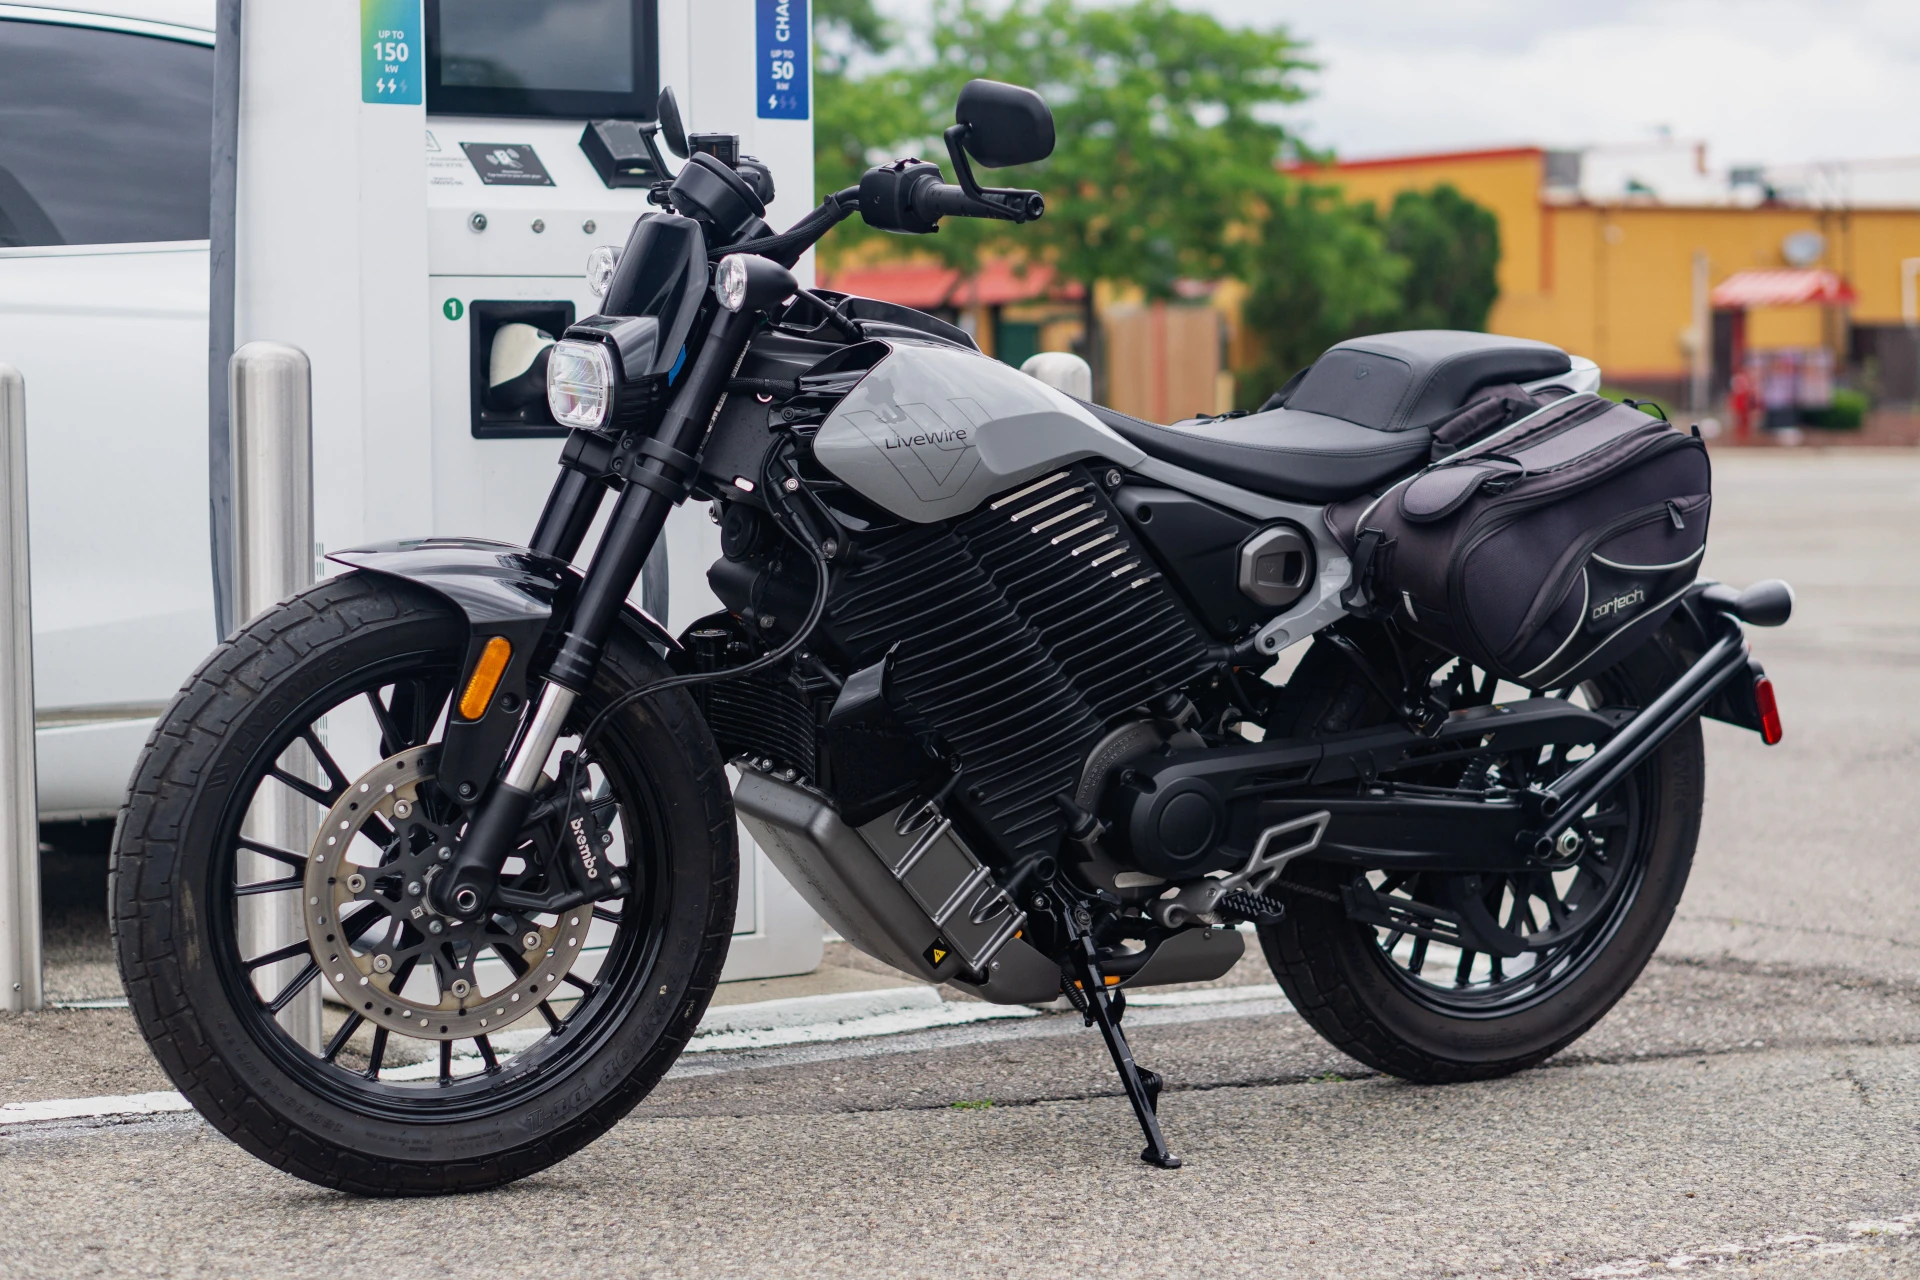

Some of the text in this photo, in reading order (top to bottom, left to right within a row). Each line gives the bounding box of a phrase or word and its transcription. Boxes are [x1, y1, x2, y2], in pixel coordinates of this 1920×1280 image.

[776, 0, 790, 41] CHA
[378, 30, 405, 40] UP TO
[373, 42, 409, 62] 150
[770, 49, 795, 59] UP TO
[385, 64, 399, 74] kW
[771, 61, 795, 80] 50
[448, 301, 457, 318] 1
[885, 428, 967, 450] LiveWire
[1592, 589, 1645, 620] cortech
[232, 655, 344, 757] LiveWire
[570, 817, 598, 879] brembo
